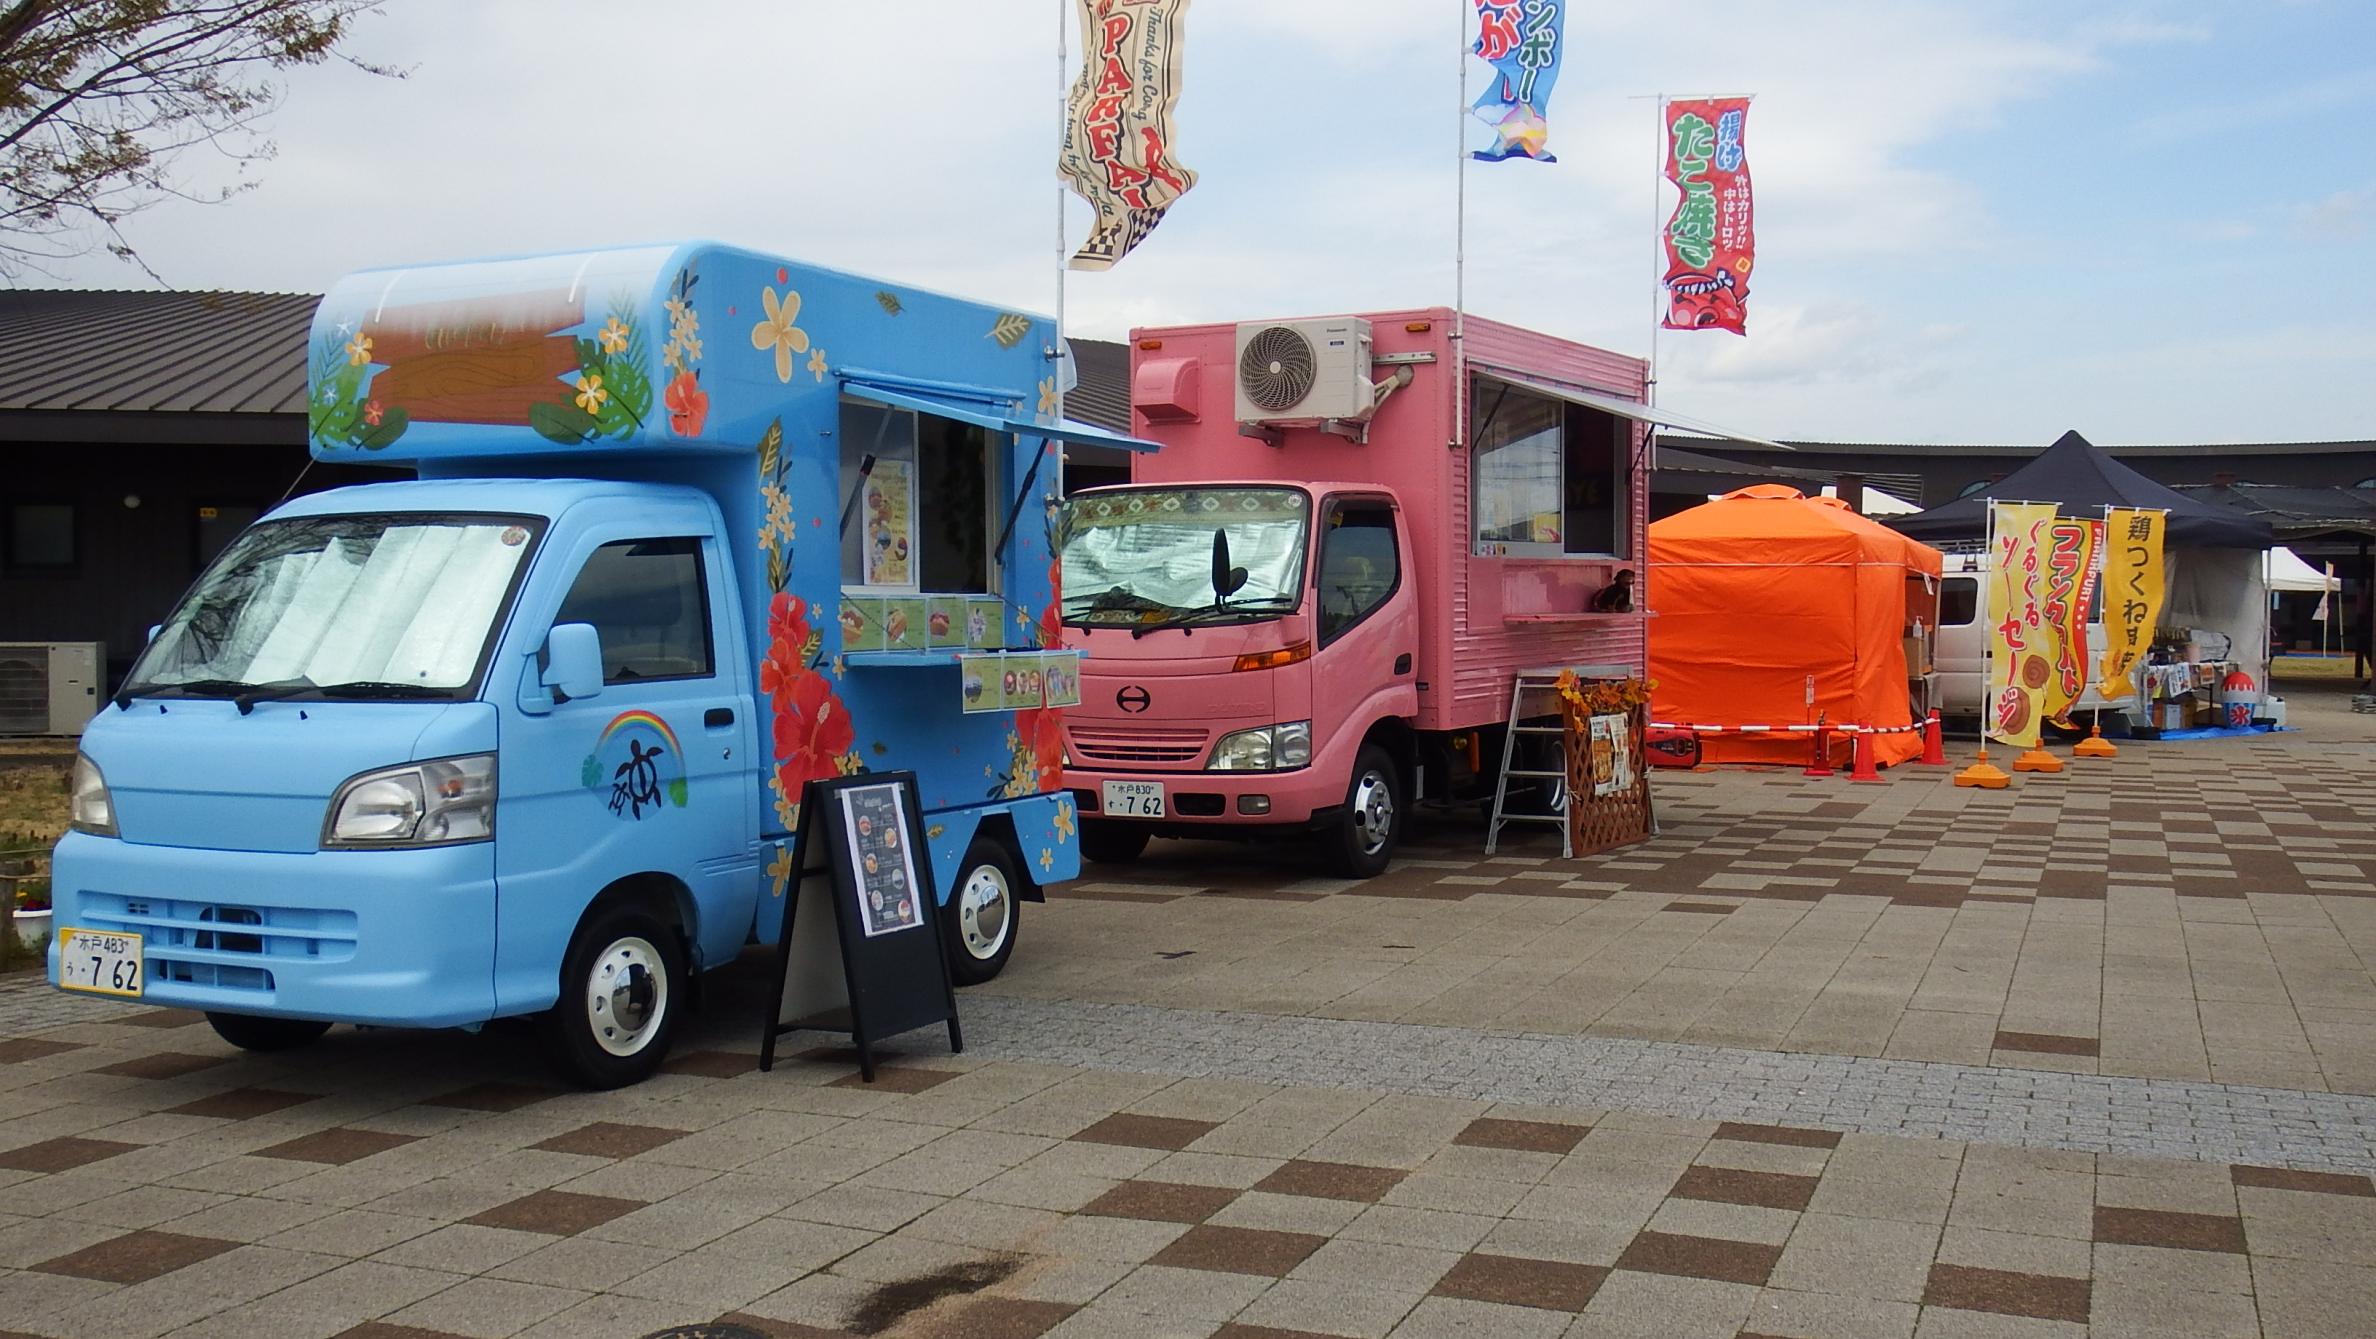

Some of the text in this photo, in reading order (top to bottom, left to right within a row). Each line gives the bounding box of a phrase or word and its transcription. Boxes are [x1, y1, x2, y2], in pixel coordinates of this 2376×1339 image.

[1138, 58, 1158, 81] for
[1145, 7, 1163, 57] Thanks
[1672, 112, 1715, 268] たこ焼き
[2022, 519, 2046, 629] ぐるぐる
[1998, 536, 2025, 728] ソーセージ
